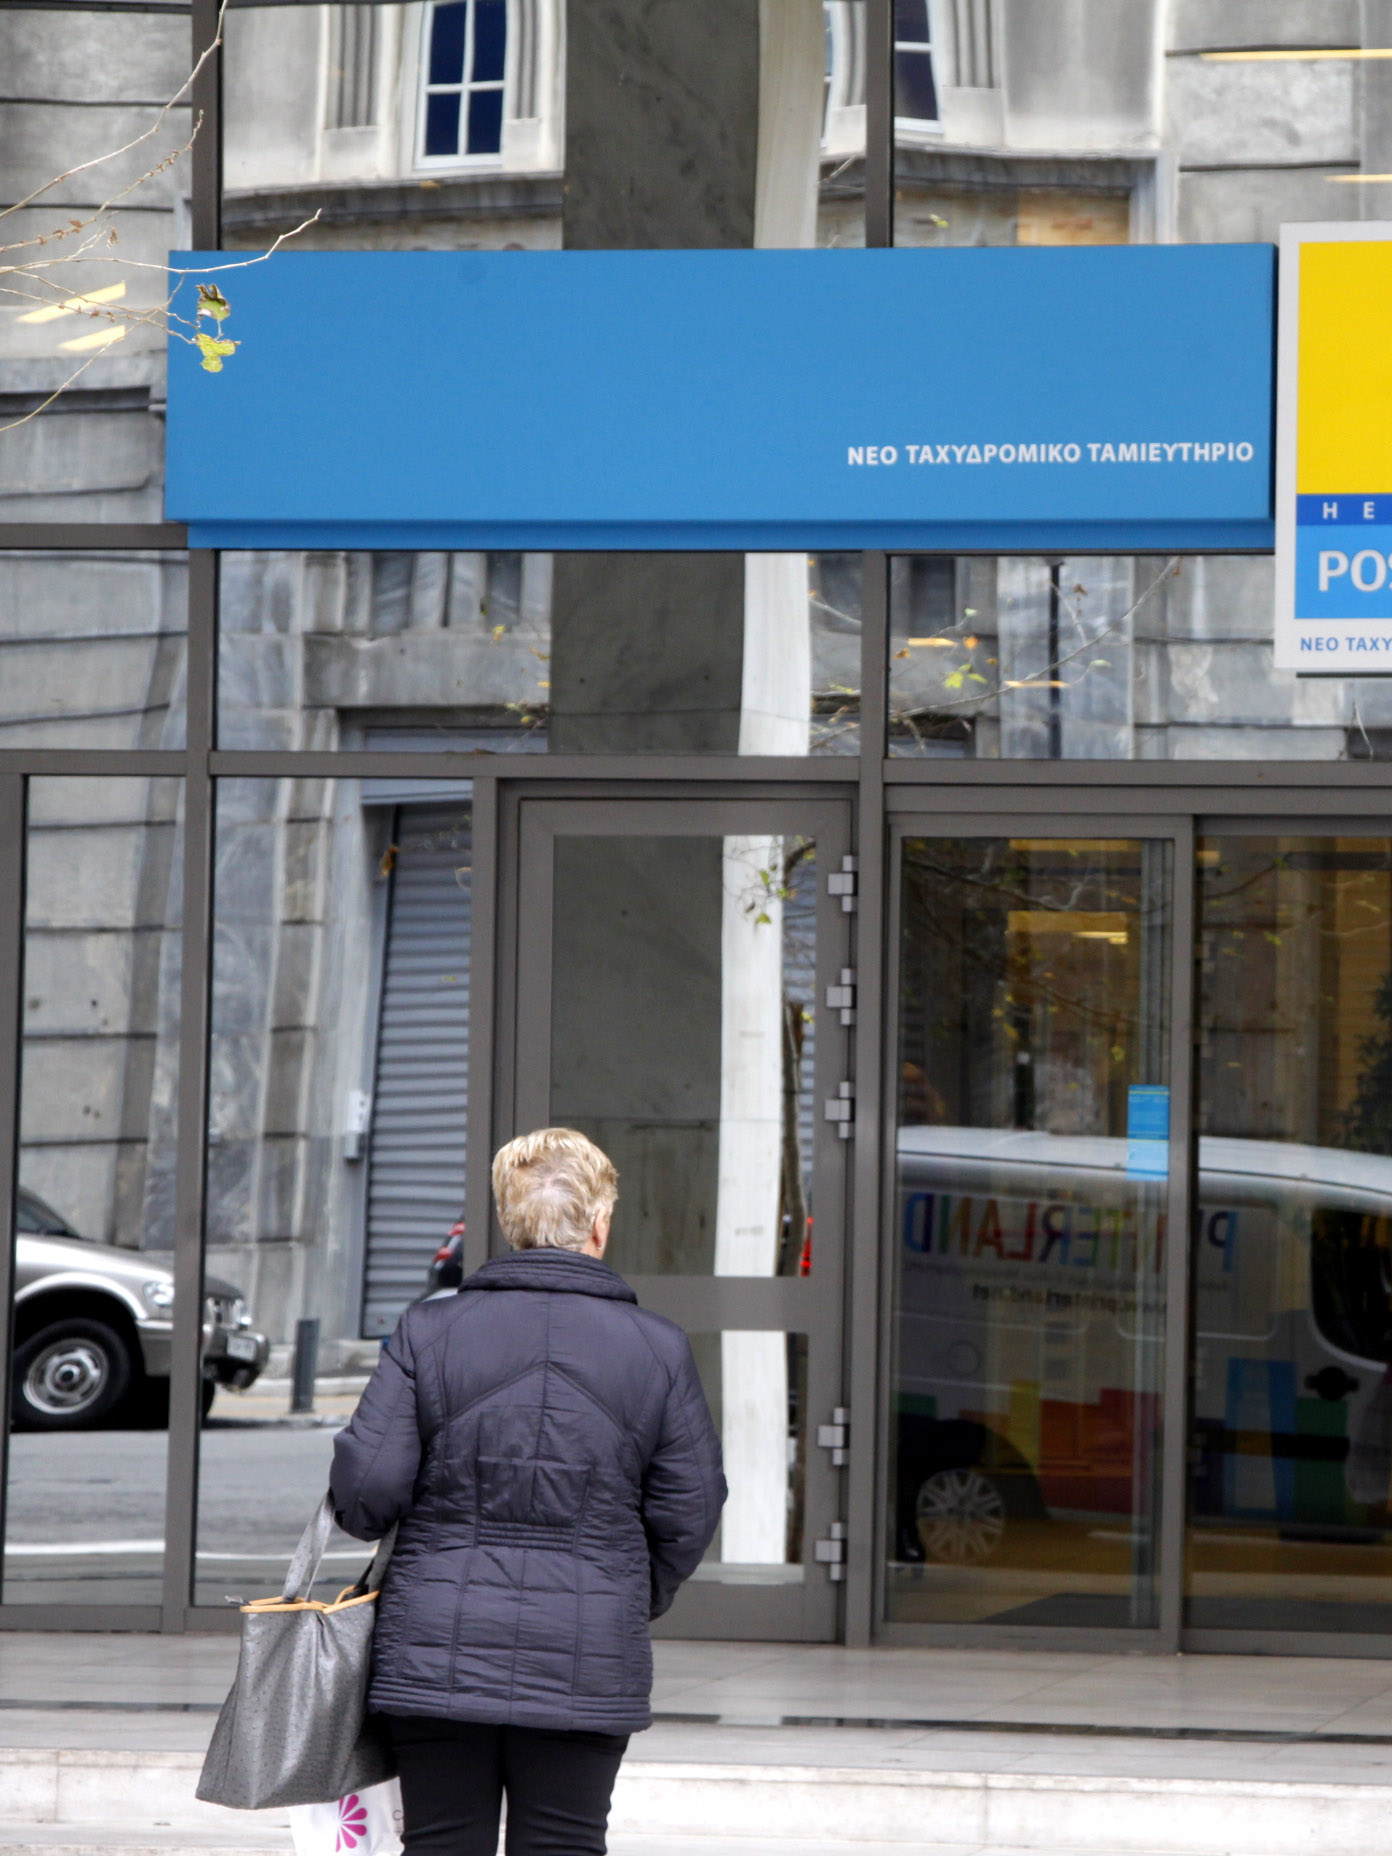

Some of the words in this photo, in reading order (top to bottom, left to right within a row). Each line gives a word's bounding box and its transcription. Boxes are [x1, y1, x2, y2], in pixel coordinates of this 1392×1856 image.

[847, 445, 898, 466] ΝΕΟ
[905, 442, 1082, 464] ΤΑΧΥΔΡΟΜΙΚΟ
[1086, 441, 1254, 463] ΤΑΜΙΕΥΤΗΡΙΟ
[1300, 636, 1340, 652] ΝΕΟ
